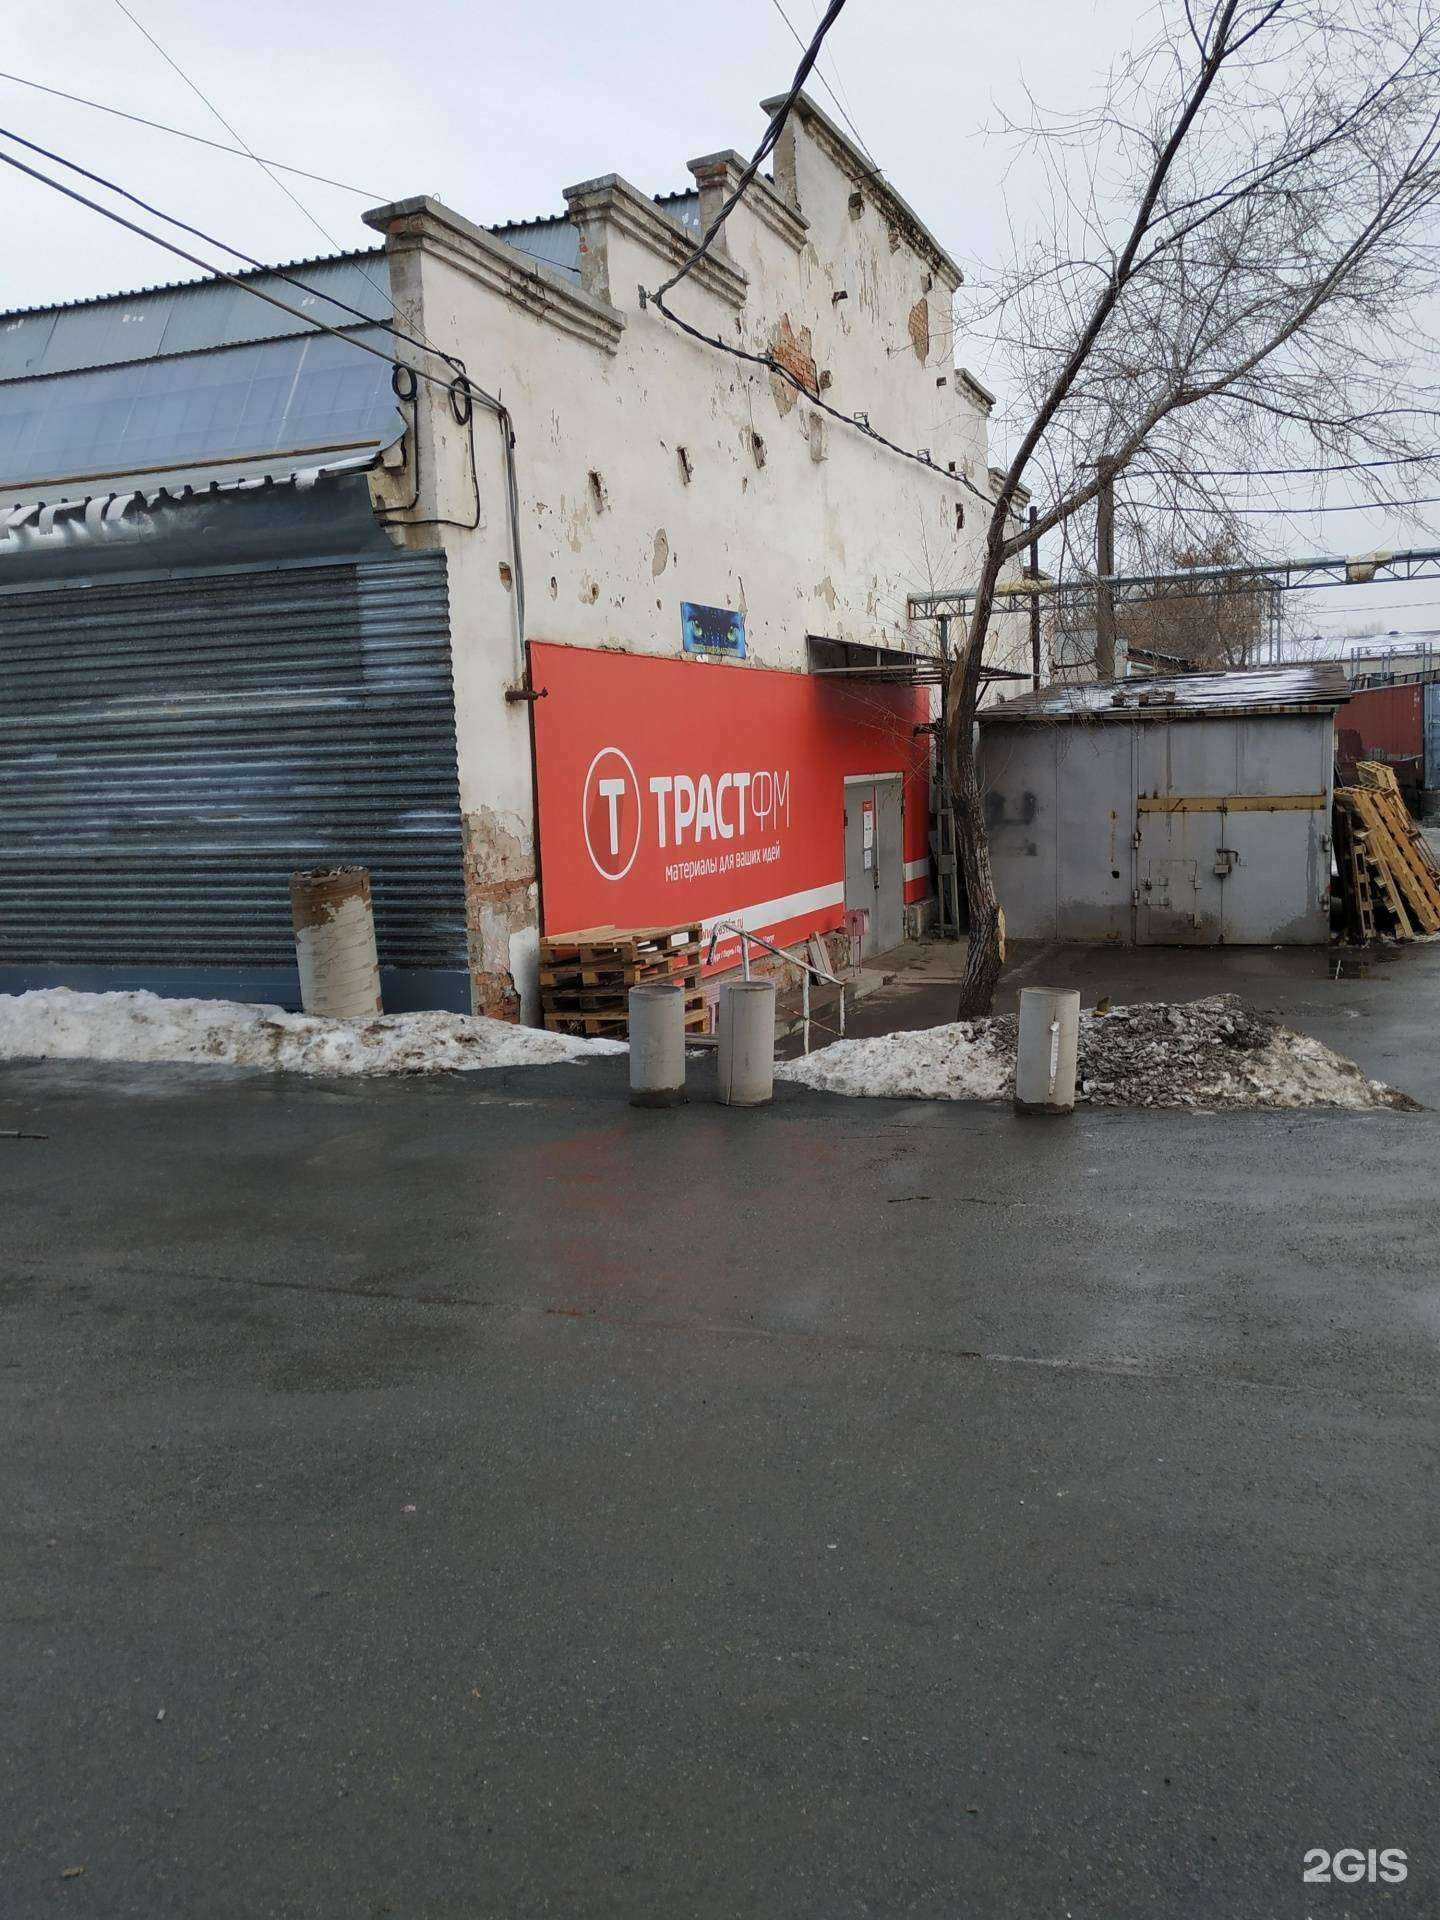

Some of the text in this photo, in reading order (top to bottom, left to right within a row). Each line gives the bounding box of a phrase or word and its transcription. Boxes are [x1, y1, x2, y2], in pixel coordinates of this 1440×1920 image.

[650, 770, 790, 848] ТРАСТФМ
[665, 840, 781, 882] материалы для ваших идей
